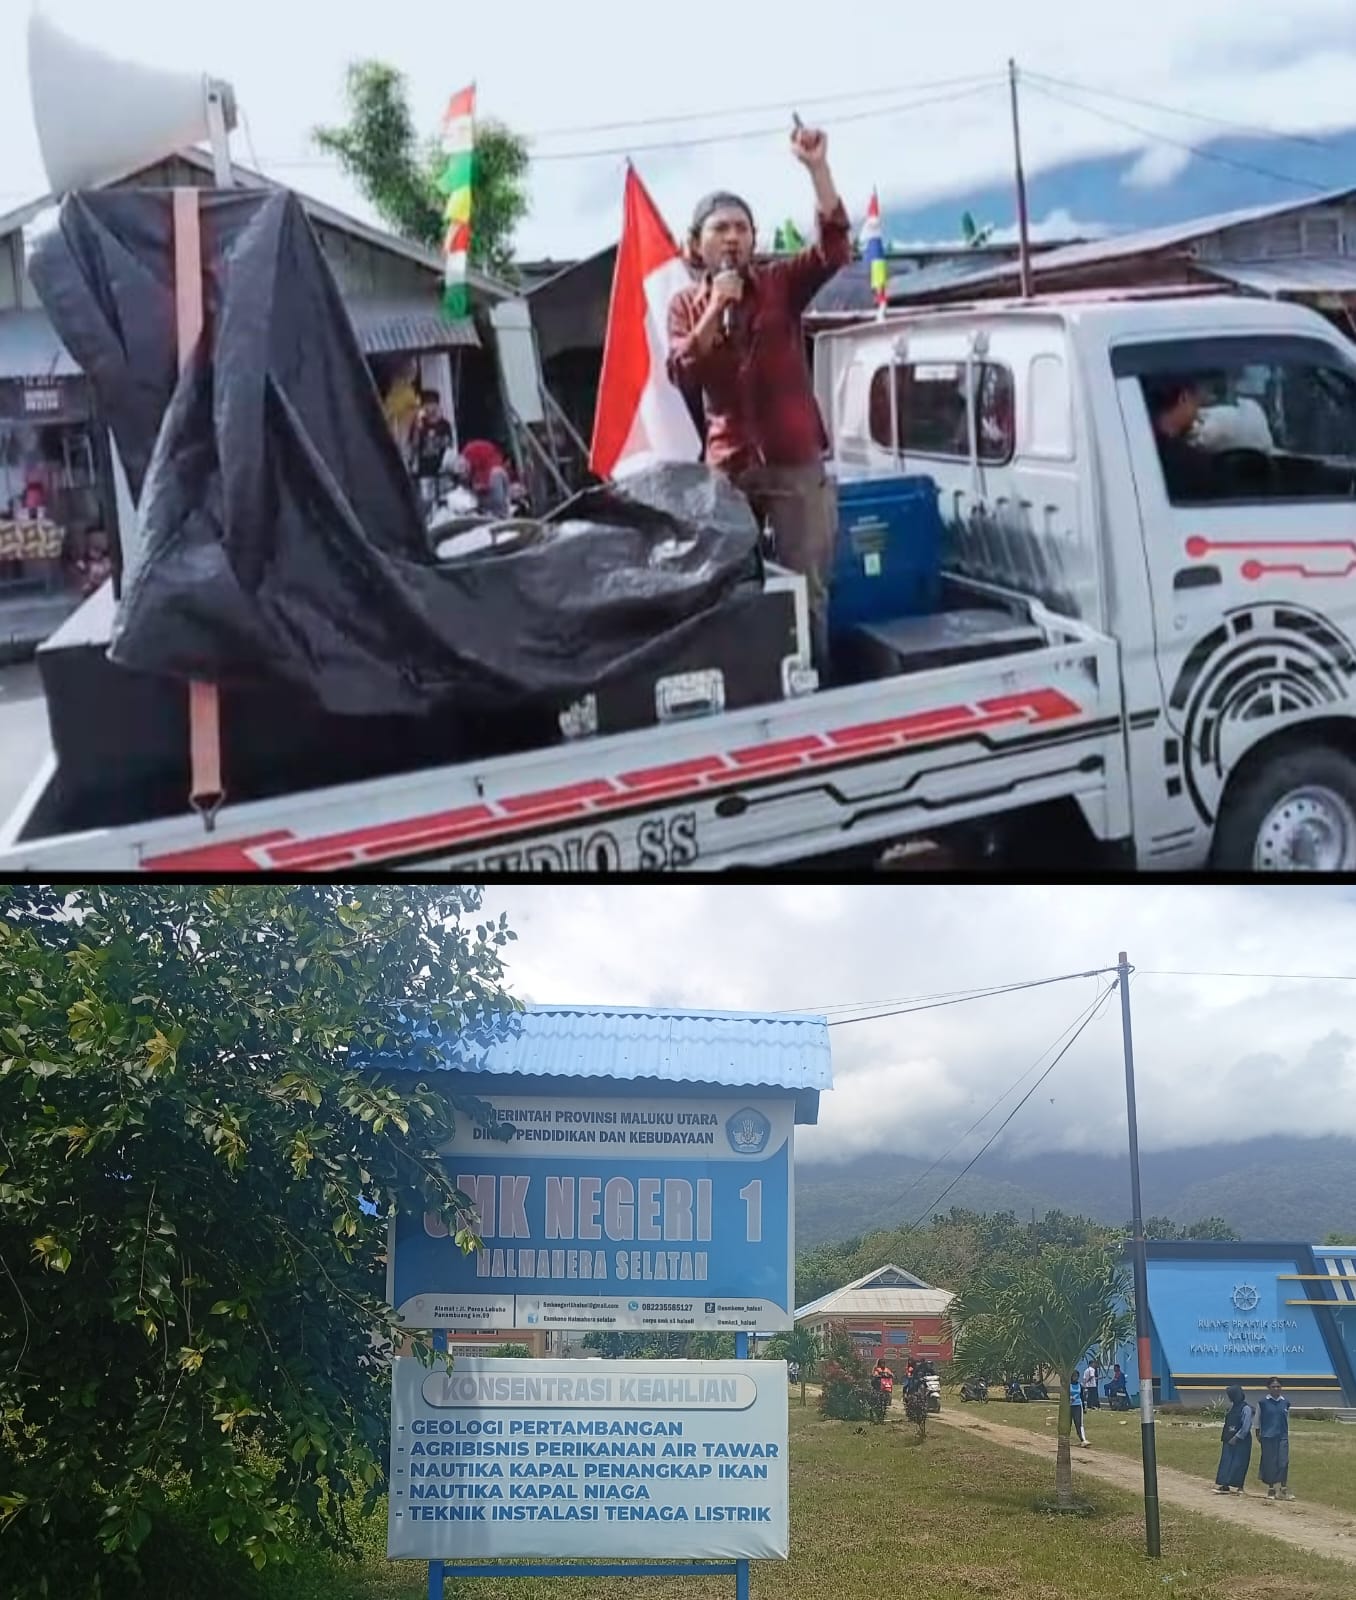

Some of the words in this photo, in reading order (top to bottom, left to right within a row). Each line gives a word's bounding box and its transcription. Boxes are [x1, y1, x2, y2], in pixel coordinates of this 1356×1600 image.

[637, 811, 699, 870] SS
[469, 1108, 552, 1124] ERINTAH
[555, 1110, 617, 1124] PROVINSI
[620, 1111, 674, 1125] MALUKU
[677, 1112, 718, 1126] UTARA
[516, 1128, 596, 1143] PENDIDIKAN
[599, 1130, 626, 1143] DAN
[629, 1130, 714, 1145] KEBUDAYAAN
[545, 1176, 712, 1242] NEGERI
[739, 1179, 762, 1242] 1
[477, 1248, 608, 1279] HALMAHERA
[615, 1250, 708, 1281] SELATAN
[1198, 1319, 1229, 1328] RUANG
[1271, 1319, 1298, 1329] SISWA
[1228, 1331, 1267, 1341] NAUTIKA
[1190, 1343, 1219, 1353] KAPAL
[1223, 1343, 1280, 1353] PENANGKAP
[1282, 1344, 1305, 1354] IKAN
[442, 1376, 612, 1402] KONSENTRASI
[619, 1378, 737, 1403] KEAHLIAN
[411, 1419, 503, 1435] GEOLOGI
[509, 1420, 683, 1436] PERTAMBANGAN
[410, 1441, 530, 1457] AGRIBISNIS
[535, 1442, 656, 1457] PERIKANAN
[661, 1442, 697, 1457] AIR
[702, 1443, 779, 1458] TAWAR
[410, 1462, 504, 1478] NAUTIKA
[509, 1463, 578, 1478] KAPAL
[584, 1463, 713, 1479] PENANGKAP
[718, 1464, 768, 1479] IKAN
[409, 1484, 504, 1499] NAUTIKA
[509, 1484, 578, 1499] KAPAL
[584, 1485, 650, 1499] NIAGA
[408, 1505, 486, 1521] TEKNIK
[491, 1505, 599, 1521] INSTALASI
[604, 1506, 689, 1521] TENAGA
[694, 1506, 772, 1522] LISTRIK
